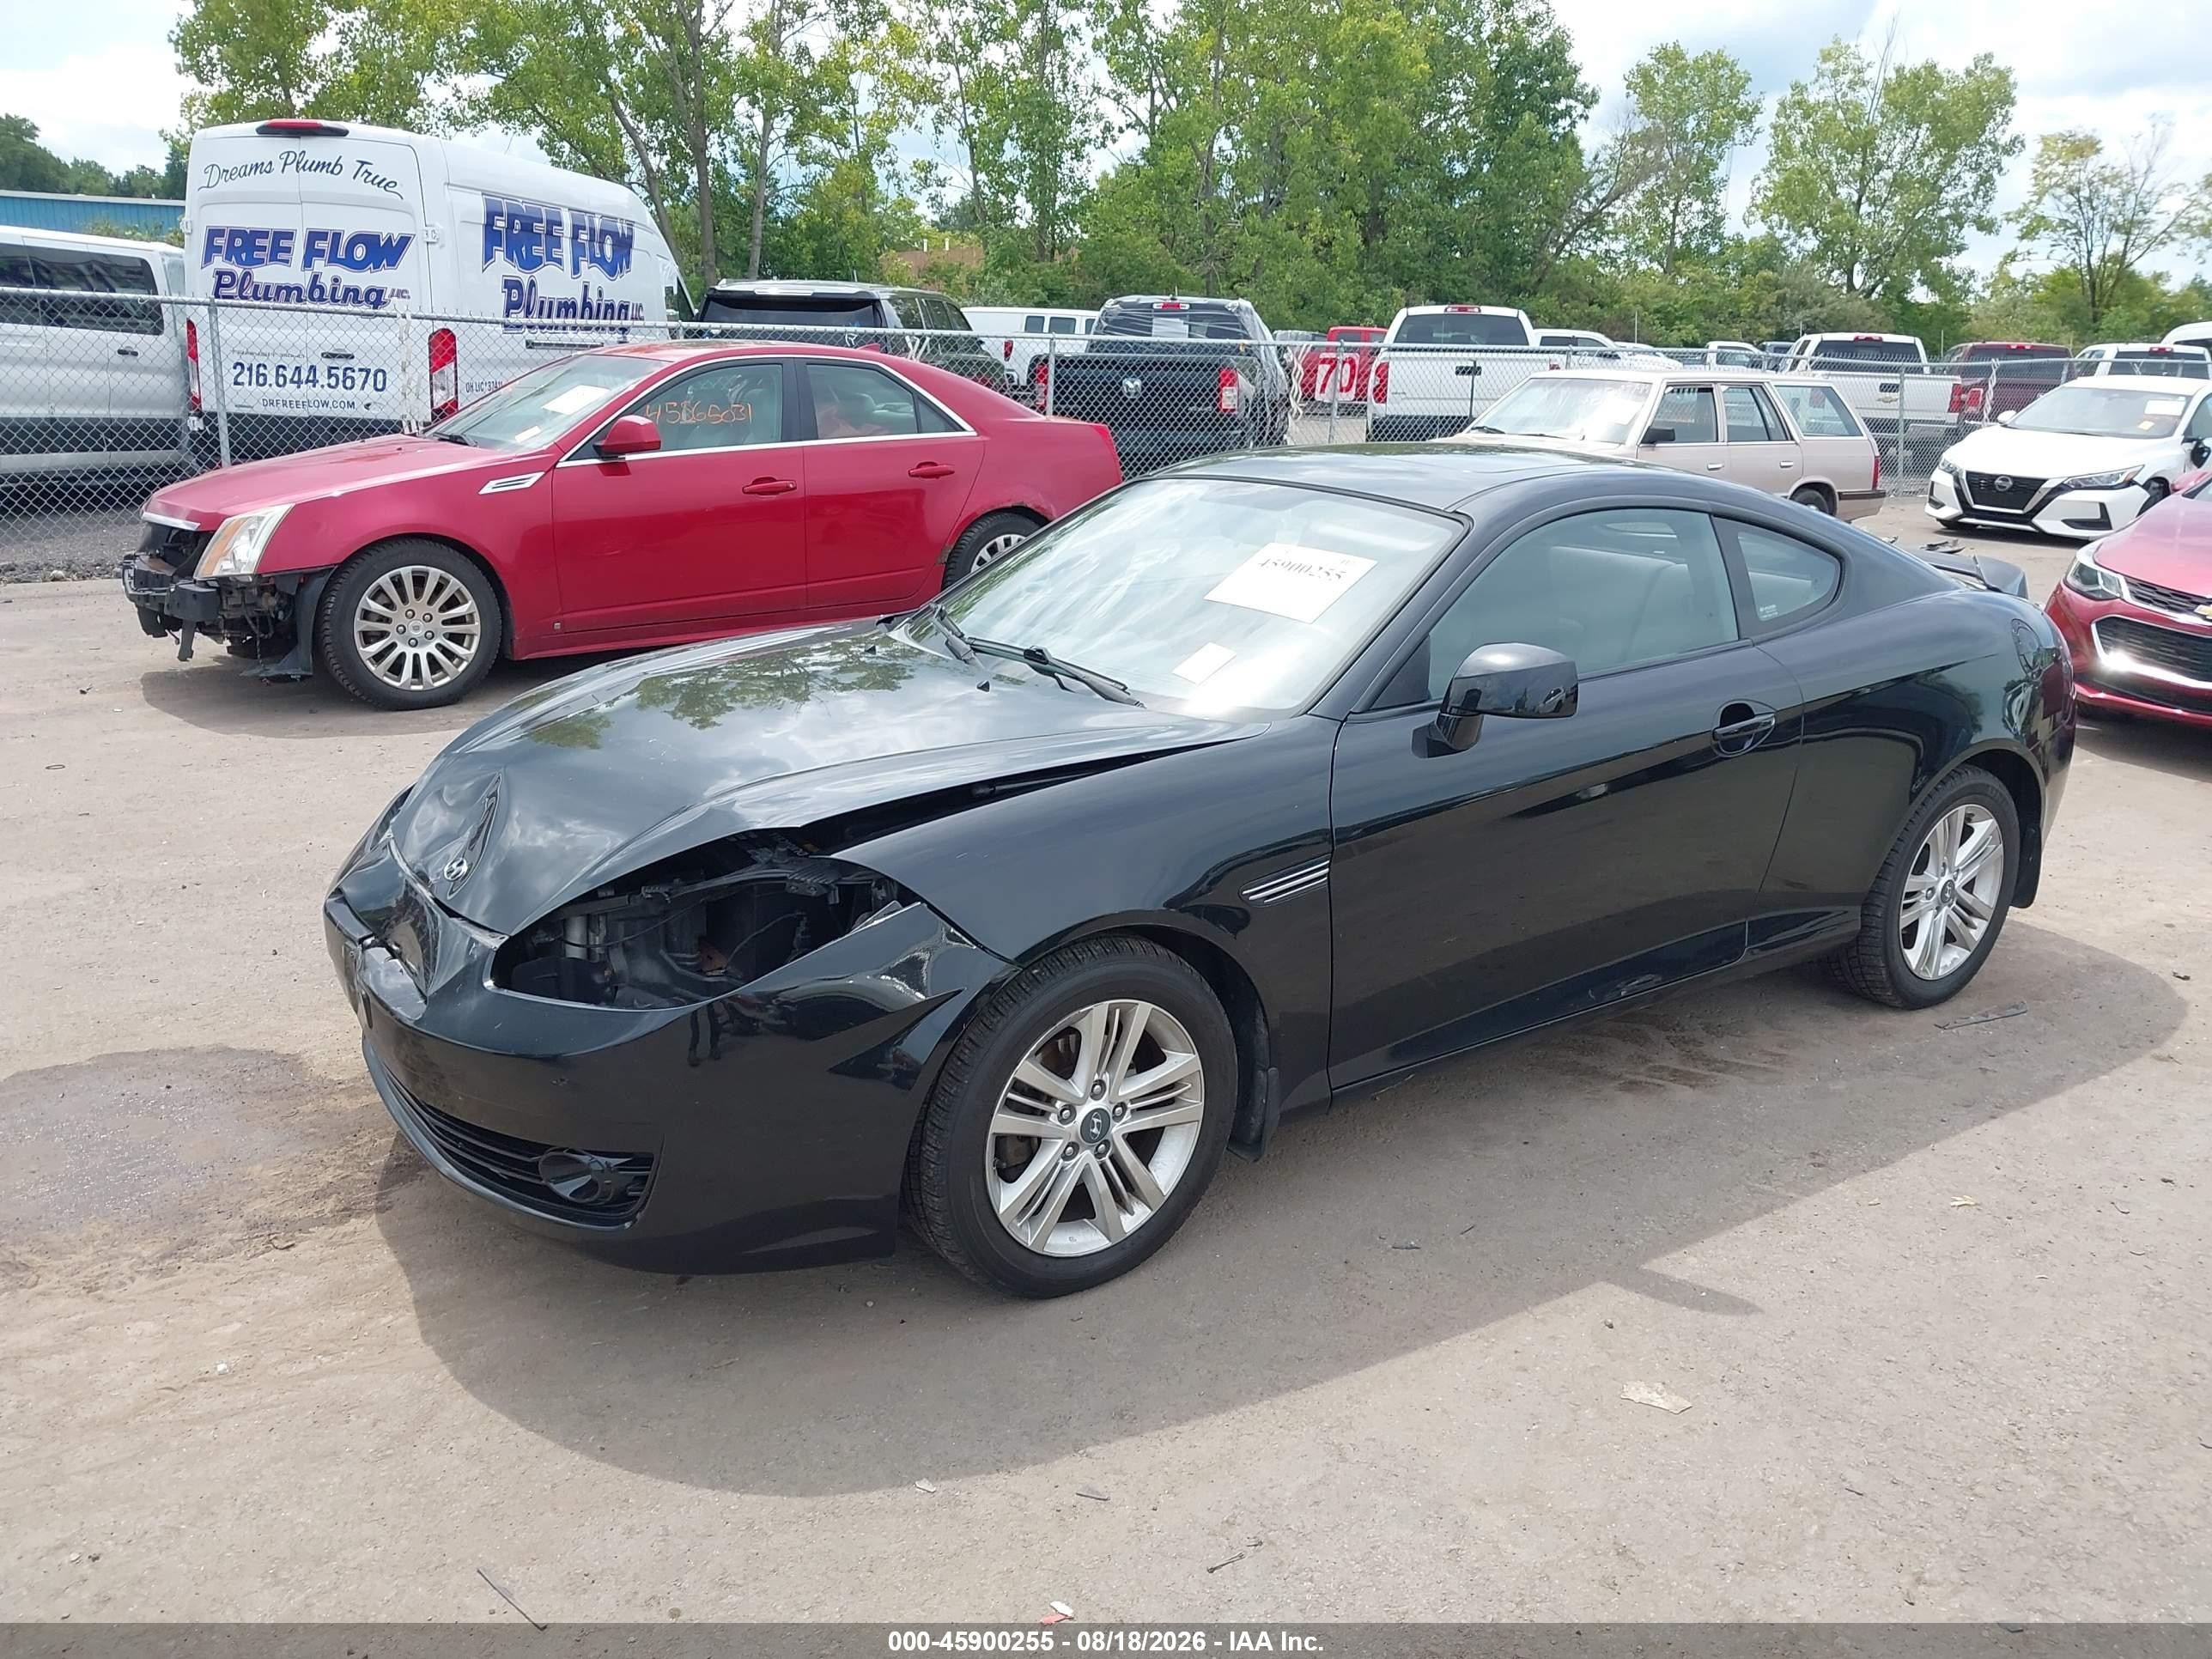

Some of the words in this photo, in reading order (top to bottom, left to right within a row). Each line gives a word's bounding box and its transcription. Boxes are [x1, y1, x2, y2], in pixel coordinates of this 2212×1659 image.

[198, 160, 275, 191] Dreams
[279, 150, 343, 175] Plumb
[352, 160, 404, 200] True
[201, 225, 297, 270] FREE
[301, 228, 416, 273] FLOW
[482, 193, 564, 274] FREE
[568, 209, 635, 282] FLOW
[212, 268, 391, 310] Plumbing
[501, 275, 631, 343] Plumbing
[232, 362, 387, 392] 216.644.5670
[1318, 356, 1356, 394] 70
[261, 398, 356, 410] DRFREEFLOW.COM
